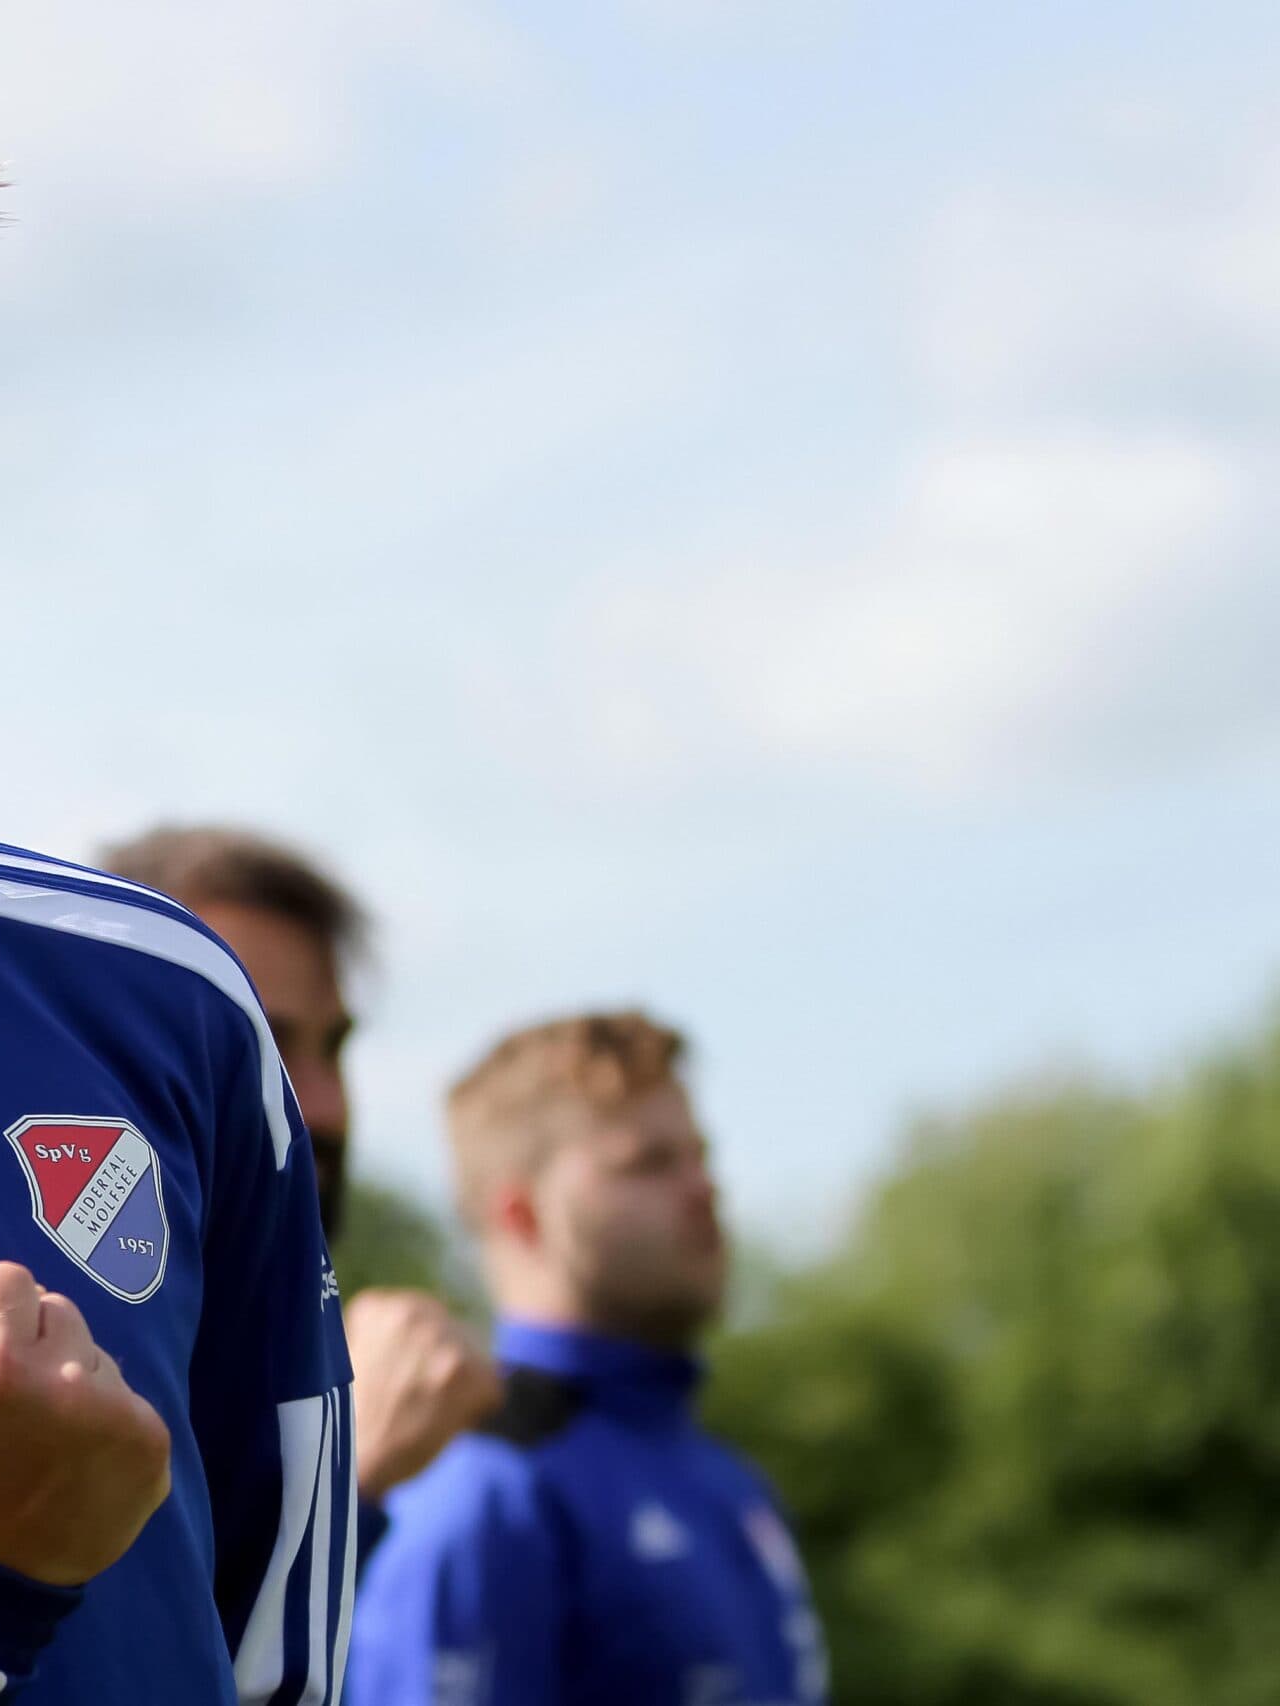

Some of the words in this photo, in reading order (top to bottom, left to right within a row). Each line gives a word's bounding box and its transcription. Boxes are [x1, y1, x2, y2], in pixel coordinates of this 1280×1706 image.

[35, 1144, 92, 1163] SpVg
[73, 1154, 127, 1225] EIDERTAL
[87, 1165, 138, 1236] MOLFSEE
[118, 1237, 154, 1257] 1957
